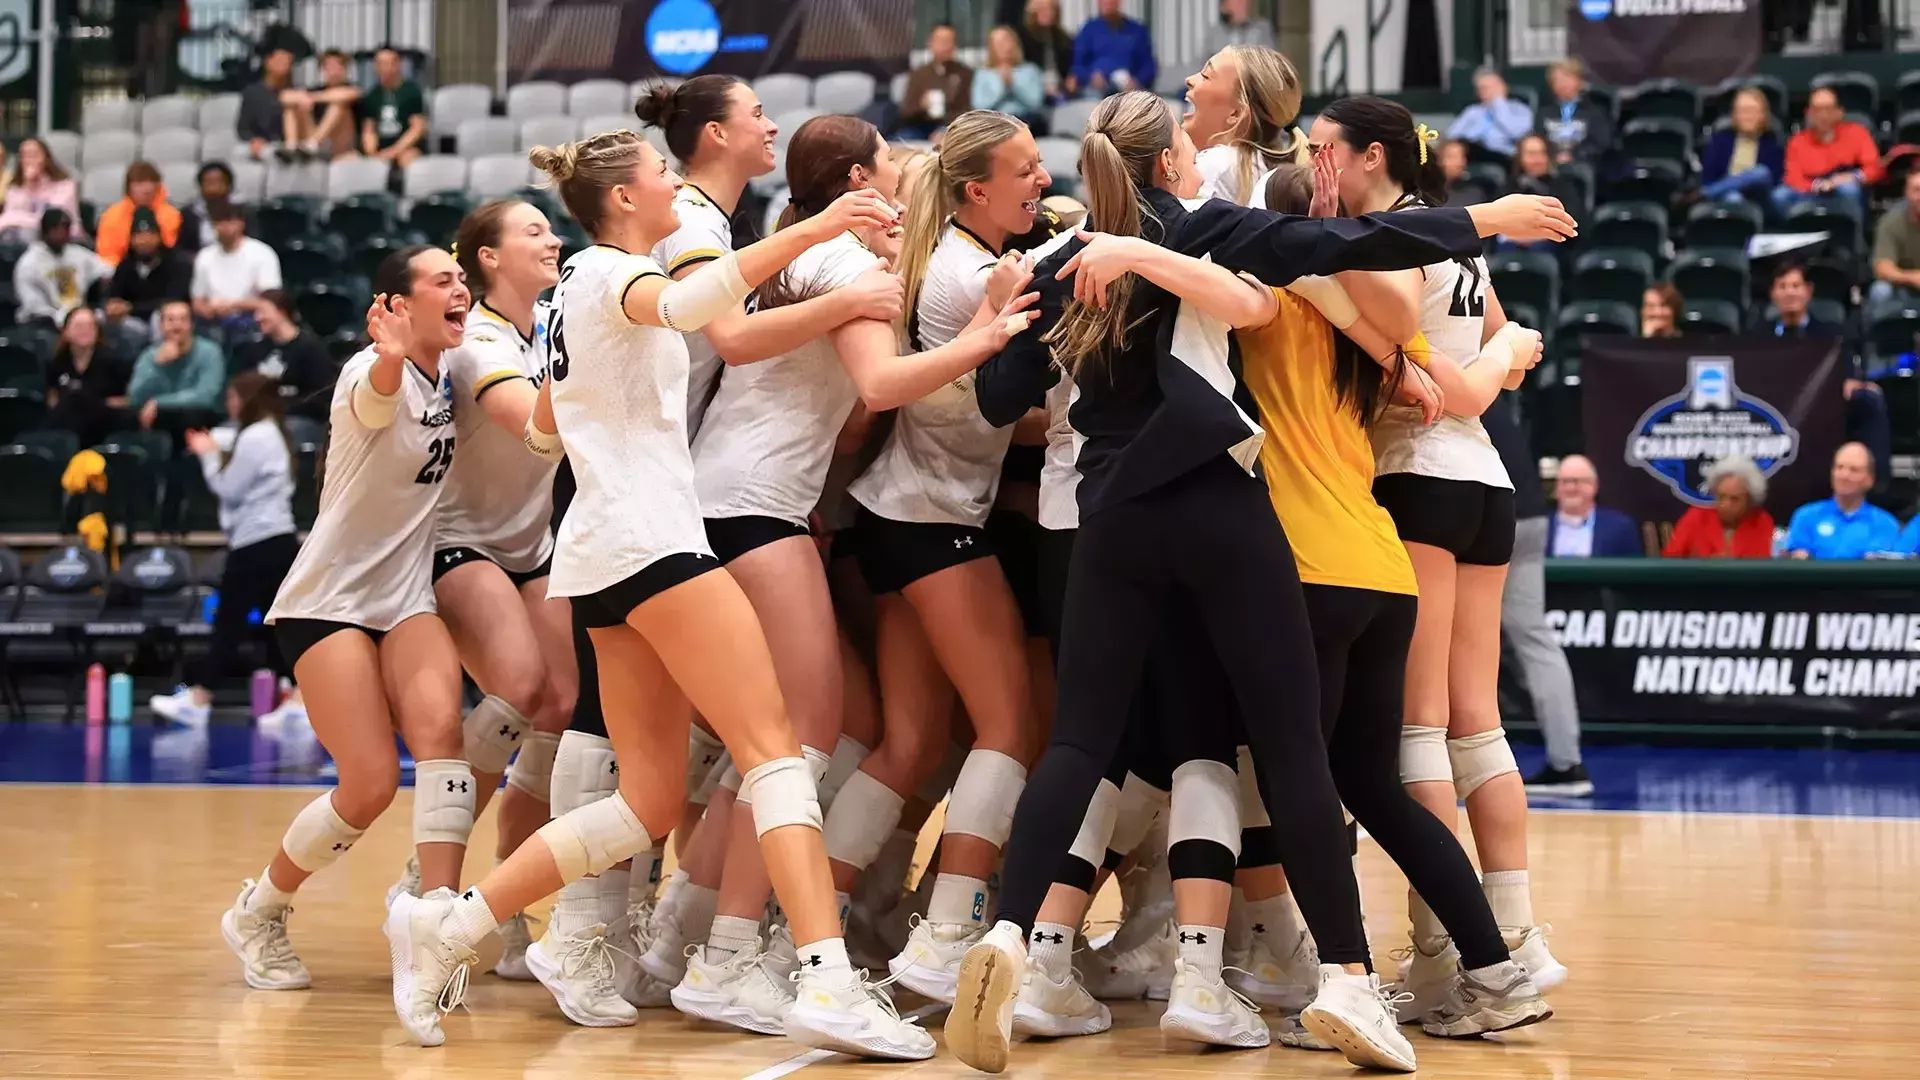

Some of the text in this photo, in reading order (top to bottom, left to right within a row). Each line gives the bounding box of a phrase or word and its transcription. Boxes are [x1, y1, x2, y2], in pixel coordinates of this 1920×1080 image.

[414, 437, 456, 484] 25
[1611, 609, 1766, 650] DIVISION
[1769, 611, 1810, 651] III
[1633, 655, 1797, 695] NATIONAL
